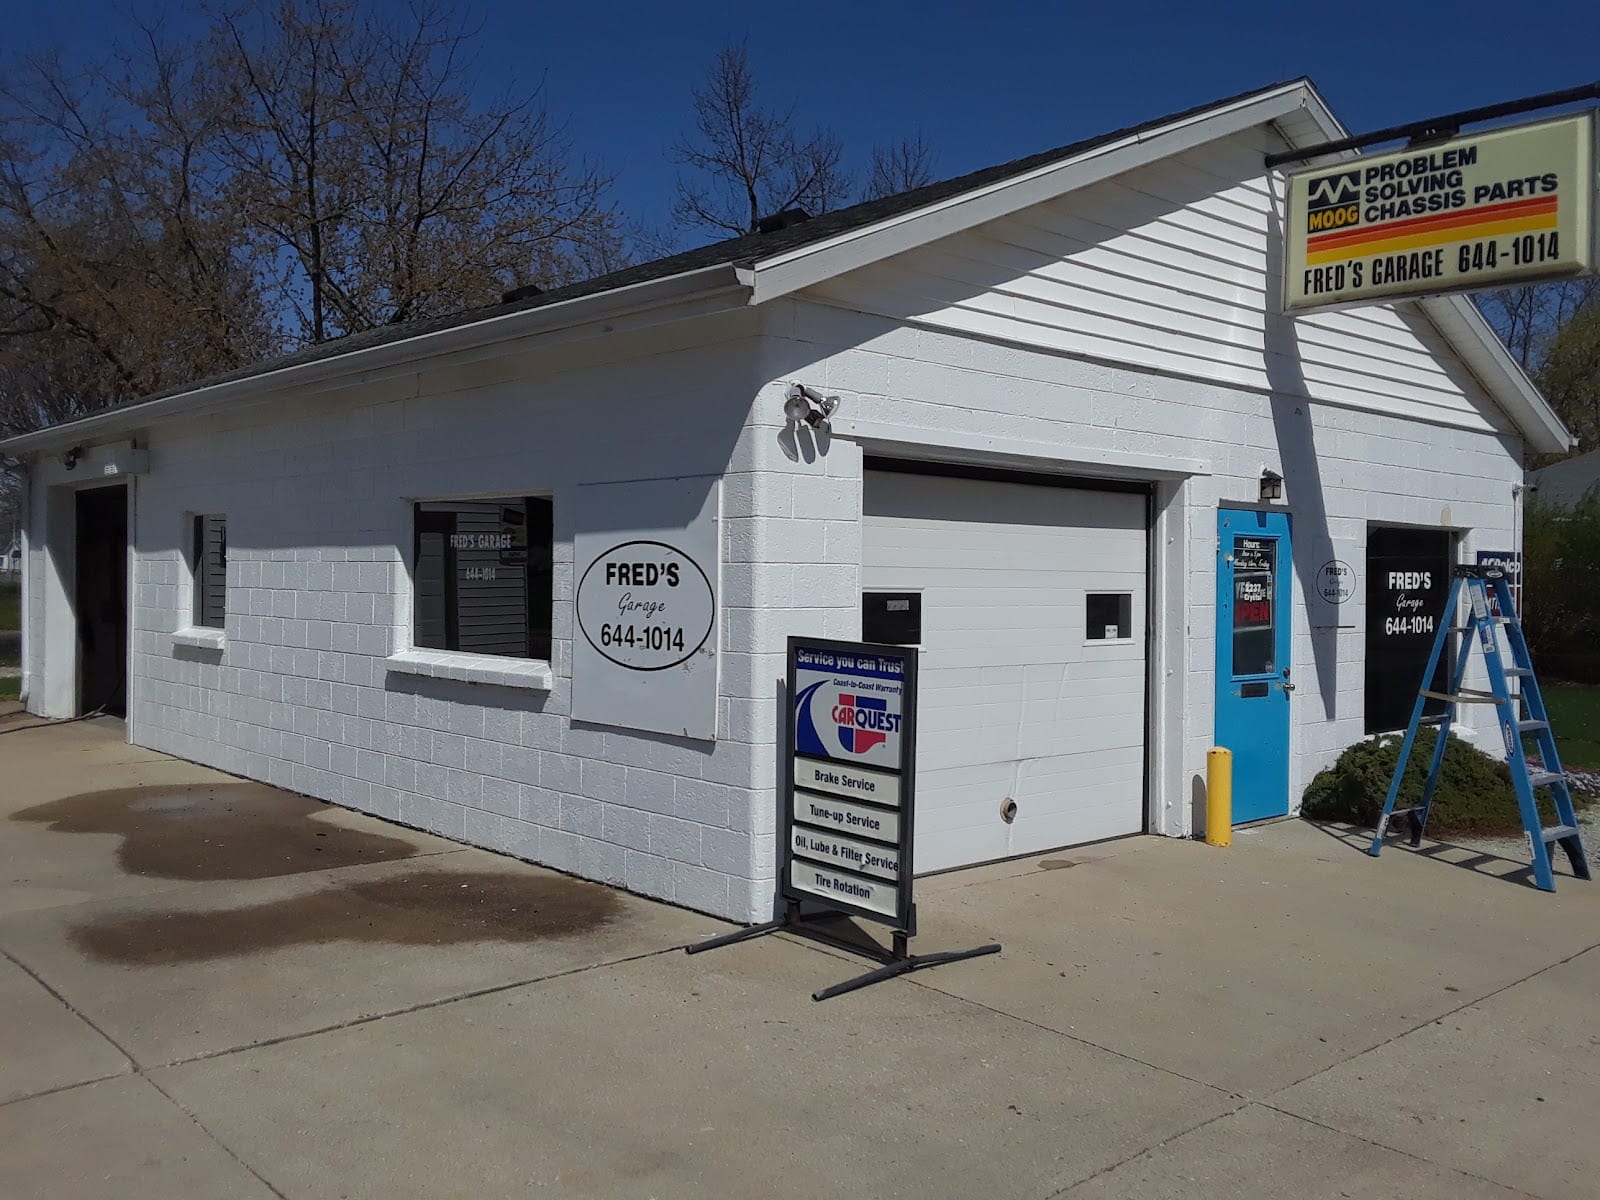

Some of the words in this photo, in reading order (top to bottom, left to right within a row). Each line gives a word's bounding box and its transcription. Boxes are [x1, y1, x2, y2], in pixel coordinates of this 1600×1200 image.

[1365, 146, 1477, 185] PROBLEM
[1365, 171, 1463, 203] SOLVING
[1365, 189, 1466, 223] CHASSIS
[1474, 173, 1558, 204] PARTS
[1309, 205, 1359, 232] MOOG
[1304, 259, 1363, 295] FRED'S
[1372, 249, 1443, 285] GARAGE
[1458, 231, 1560, 273] 644-1014
[450, 534, 475, 549] FRED'S
[478, 534, 512, 549] GARAGE
[466, 567, 496, 581] 644-1014
[606, 562, 680, 587] FRED'S
[1325, 567, 1348, 576] FRED'S
[1388, 571, 1432, 590] FRED'S
[618, 592, 665, 618] Garage
[1396, 593, 1424, 612] Garage
[601, 623, 685, 651] 644-1014
[1385, 615, 1434, 636] 644-1014
[797, 650, 834, 666] Service
[836, 656, 855, 669] you
[857, 658, 876, 671] can
[878, 658, 905, 674] Trust
[833, 678, 875, 691] Coast-to-Coast
[875, 683, 903, 695] Warranty
[832, 705, 902, 732] CARQUEST
[814, 769, 839, 785] Brake
[841, 775, 875, 792] Service
[809, 804, 844, 824] Tune-up
[846, 812, 880, 830] Service
[795, 835, 808, 850] Oil,
[810, 838, 830, 854] Lube
[832, 843, 838, 856] &
[840, 846, 863, 862] Filter
[865, 852, 899, 872] Service
[815, 873, 831, 888] Tire
[833, 878, 871, 899] Rotation
